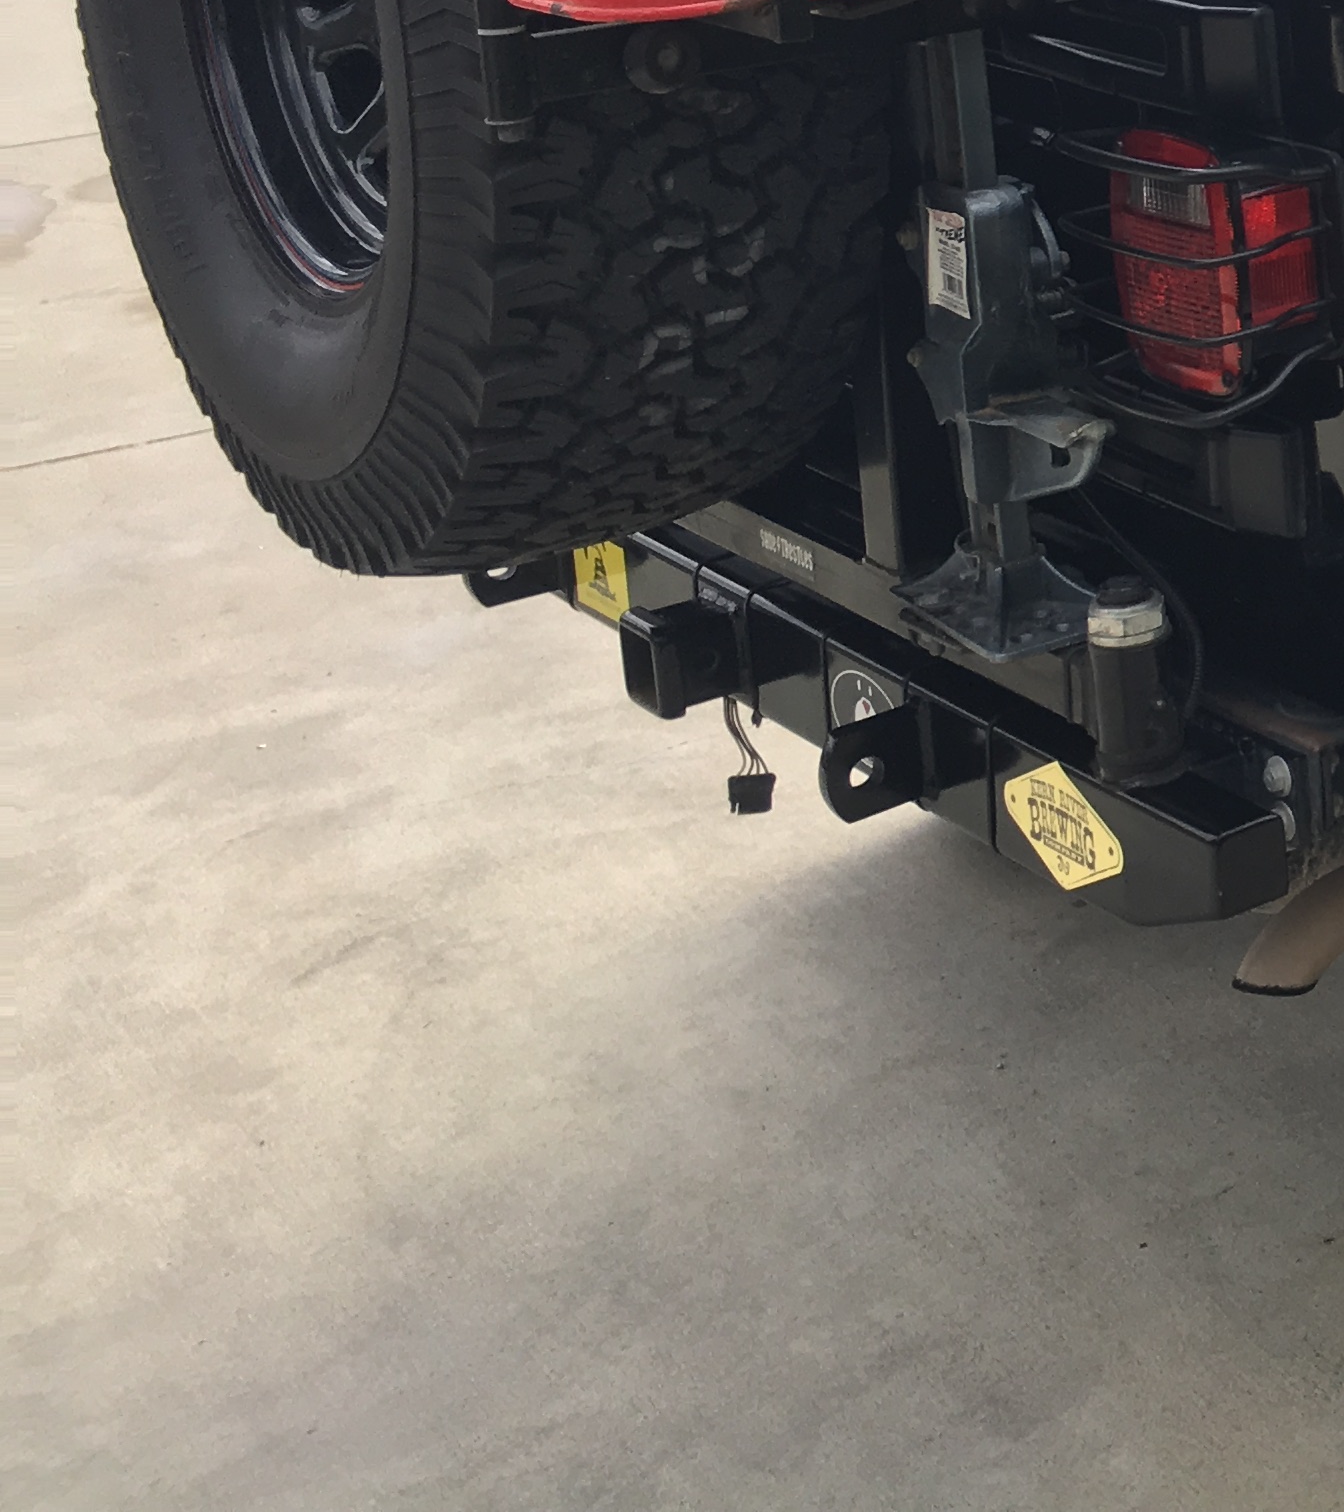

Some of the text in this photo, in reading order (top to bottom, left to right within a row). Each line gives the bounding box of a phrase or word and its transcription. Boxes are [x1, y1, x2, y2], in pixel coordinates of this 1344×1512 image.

[1029, 778, 1089, 826] KERN RIVER
[1027, 796, 1096, 873] BREWING
